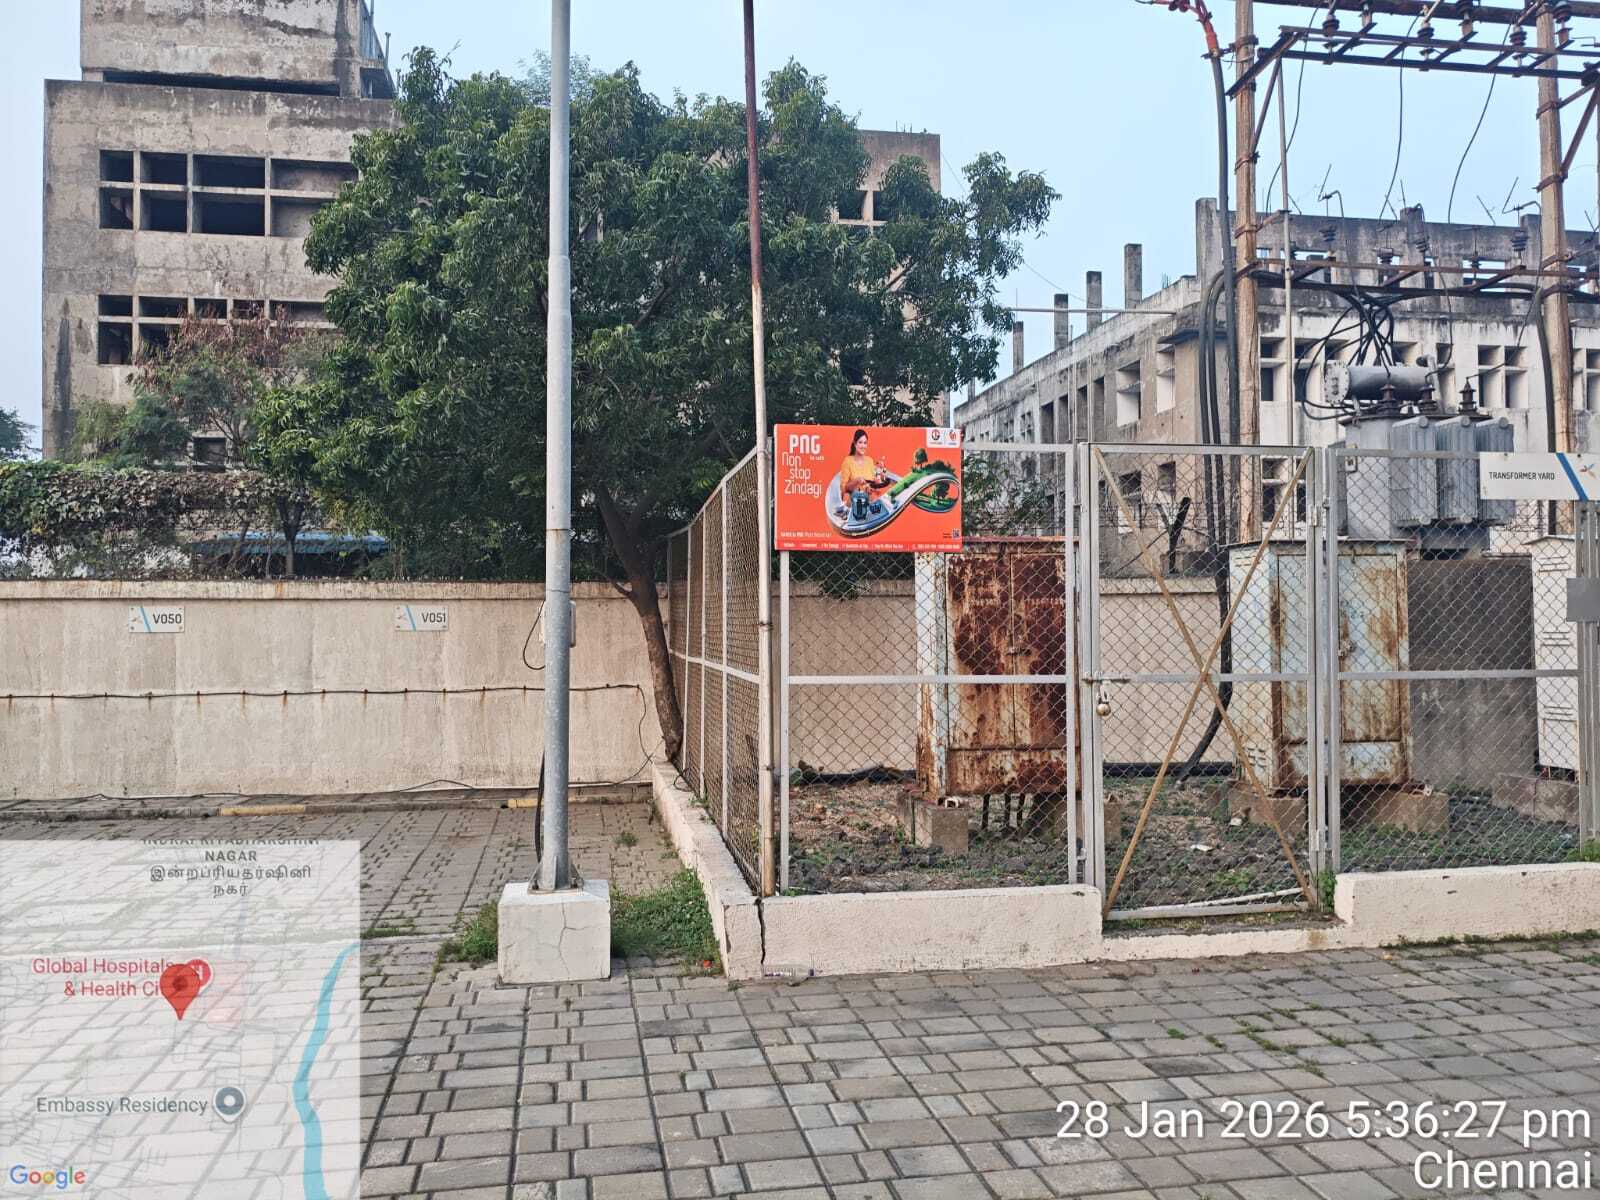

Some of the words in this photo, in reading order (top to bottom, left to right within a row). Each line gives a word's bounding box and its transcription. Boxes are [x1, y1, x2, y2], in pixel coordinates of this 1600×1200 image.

[789, 434, 821, 455] PNG
[781, 451, 802, 467] Non
[789, 465, 812, 482] stop
[1489, 471, 1537, 480] TRANSFORMER
[1538, 471, 1556, 480] YARD
[784, 479, 823, 498] Zindagi
[152, 613, 182, 625] V050
[421, 612, 446, 623] V051
